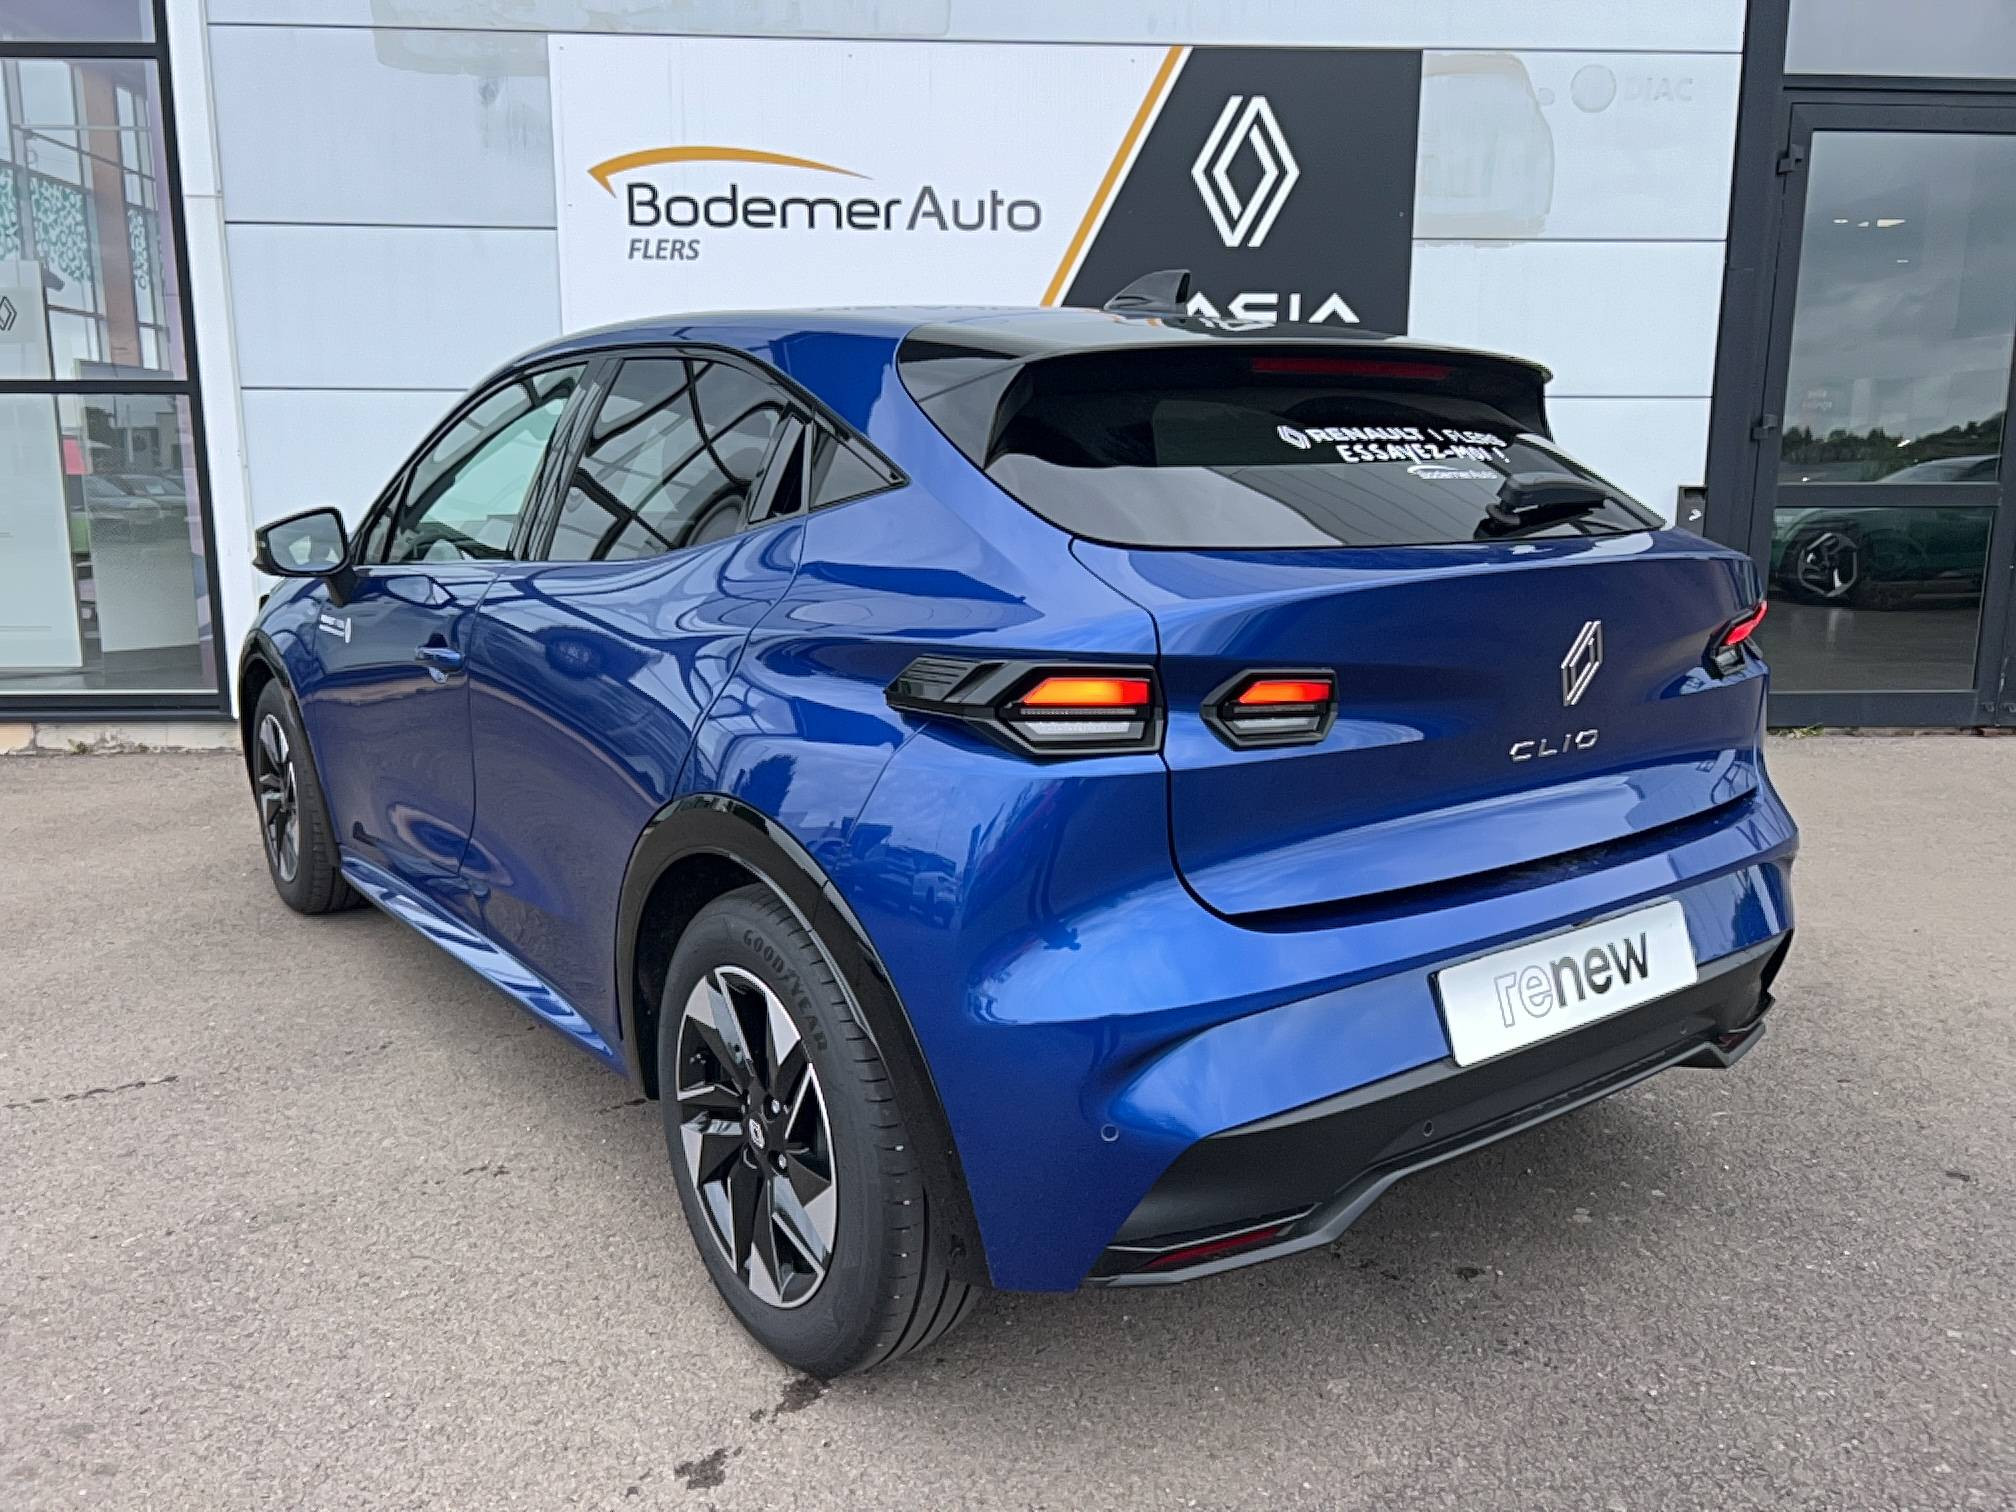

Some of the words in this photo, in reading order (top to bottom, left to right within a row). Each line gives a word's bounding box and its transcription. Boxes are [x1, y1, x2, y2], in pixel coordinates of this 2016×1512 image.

[628, 238, 701, 260] FLERS
[1305, 427, 1425, 443] RENAULT
[1509, 728, 1599, 761] CLIO
[1494, 931, 1648, 1028] renew
